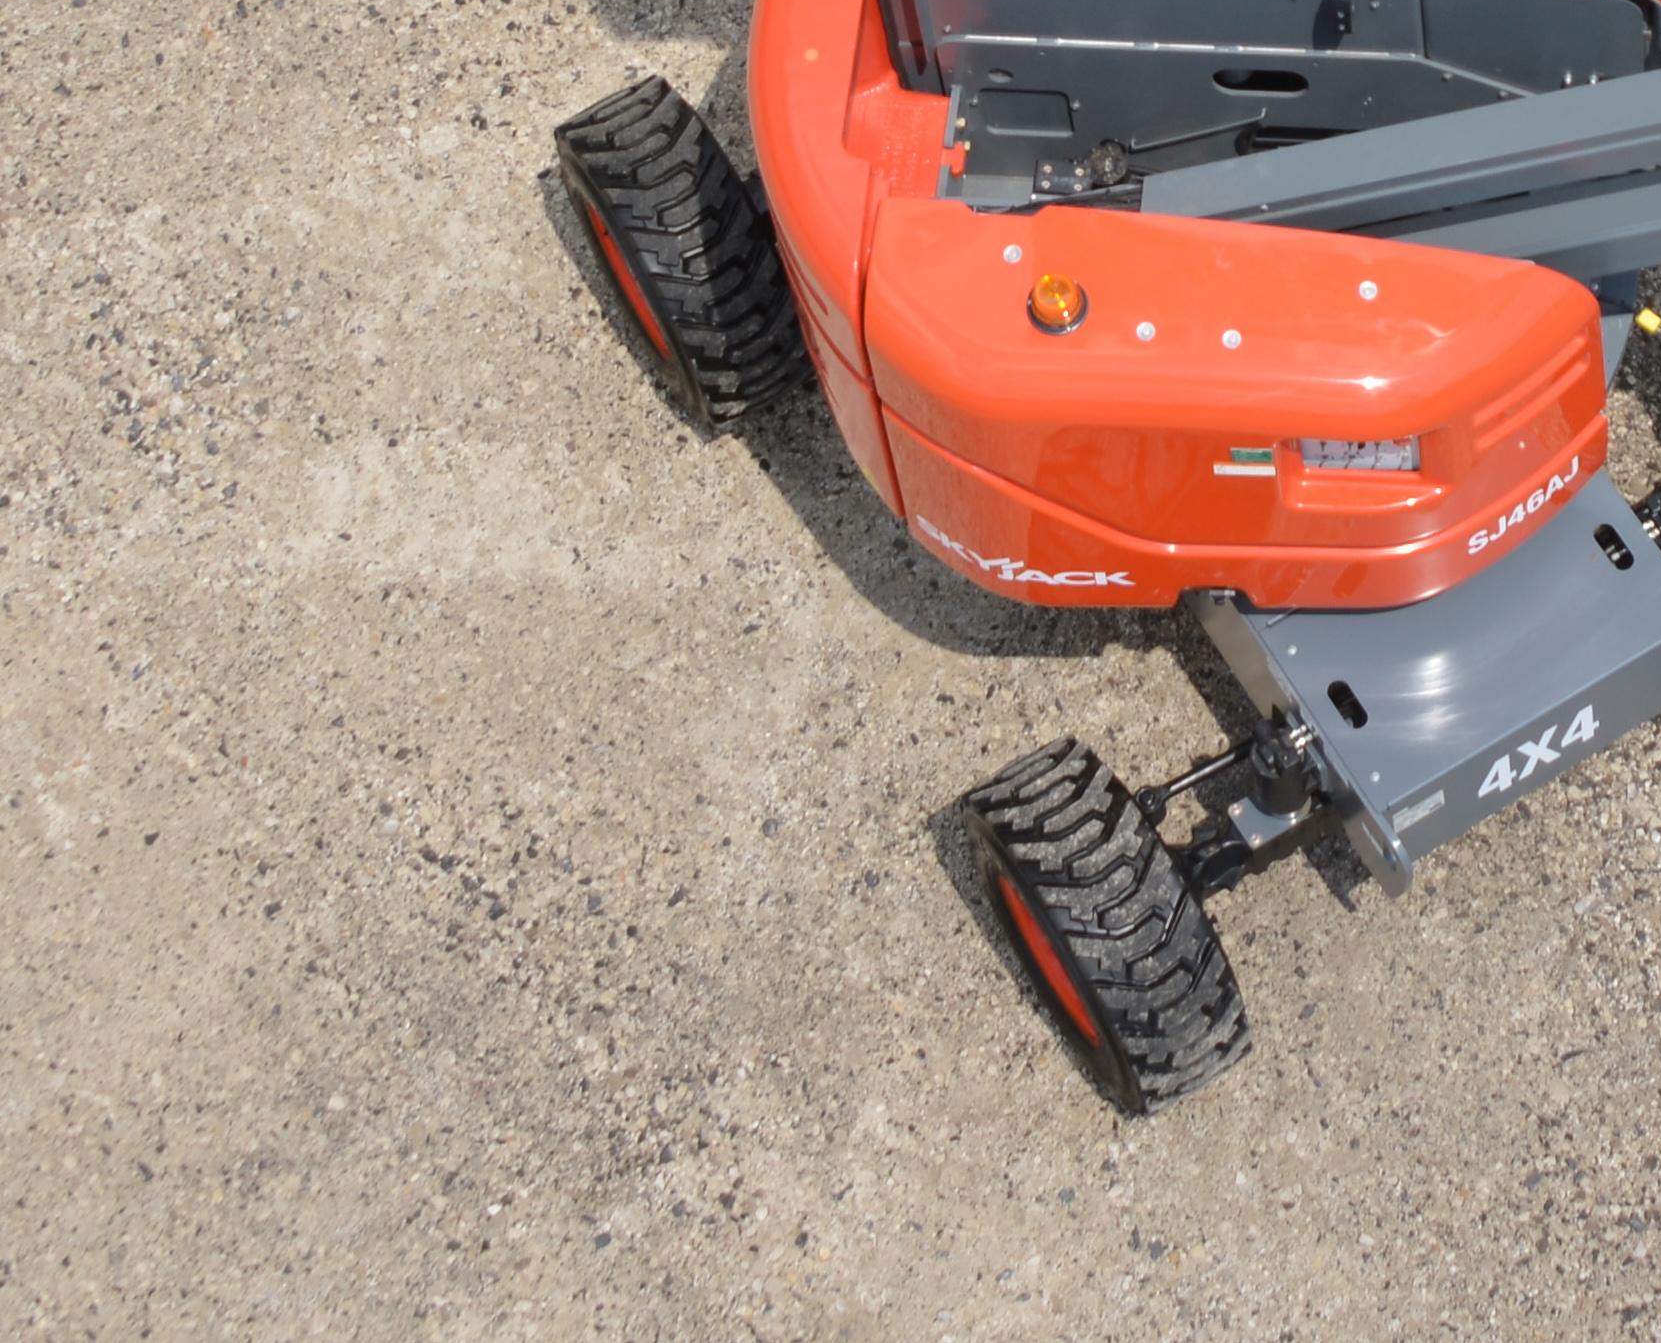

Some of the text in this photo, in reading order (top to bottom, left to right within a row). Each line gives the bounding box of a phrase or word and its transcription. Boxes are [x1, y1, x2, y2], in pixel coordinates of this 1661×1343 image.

[916, 514, 1136, 586] SKYJACK
[1468, 455, 1579, 554] SJ46AJ
[1478, 704, 1599, 798] 4X4
